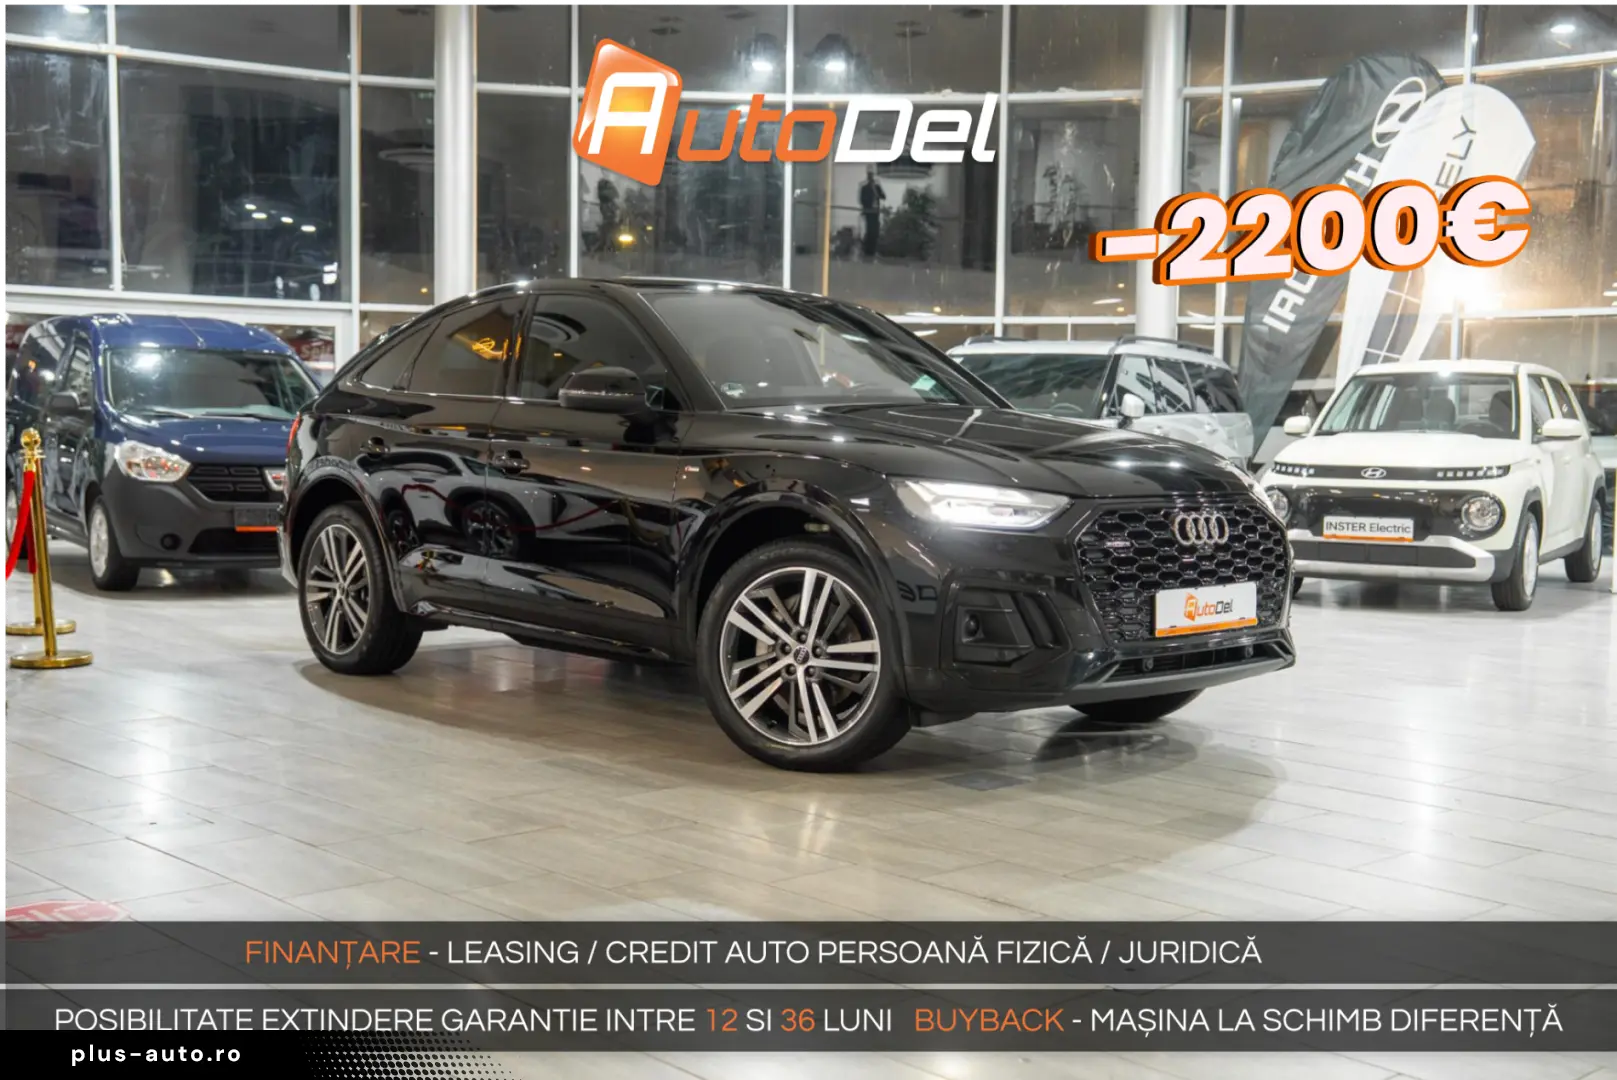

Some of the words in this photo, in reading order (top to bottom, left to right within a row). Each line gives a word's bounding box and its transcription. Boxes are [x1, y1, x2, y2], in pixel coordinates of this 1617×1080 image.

[1434, 114, 1477, 190] ELY
[1325, 521, 1366, 532] INSTER
[1369, 522, 1411, 533] Electric
[1184, 596, 1233, 619] AutoDel
